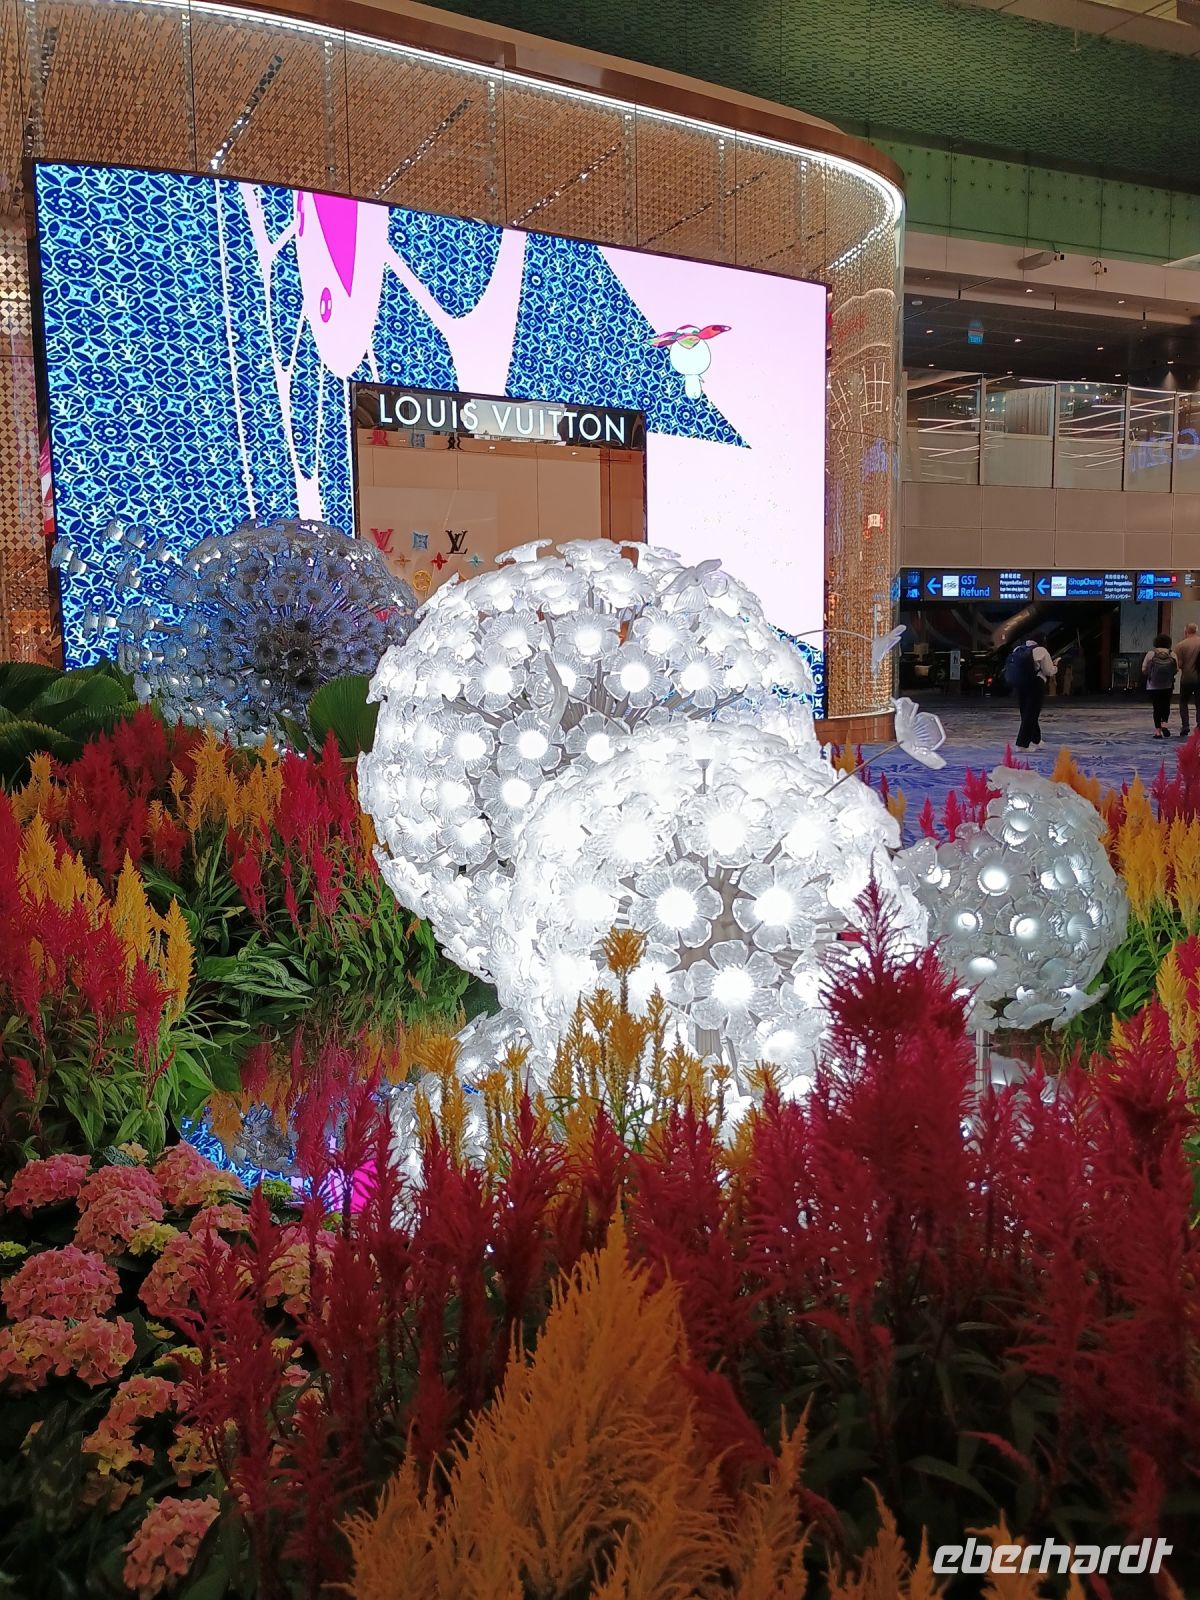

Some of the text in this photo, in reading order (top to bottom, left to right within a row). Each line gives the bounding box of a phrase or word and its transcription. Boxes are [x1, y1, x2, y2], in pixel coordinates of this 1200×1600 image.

[379, 394, 625, 444] LOUIS VUITTON
[961, 575, 977, 585] GST
[1068, 577, 1103, 587] iShopChangi
[961, 587, 990, 597] Refund
